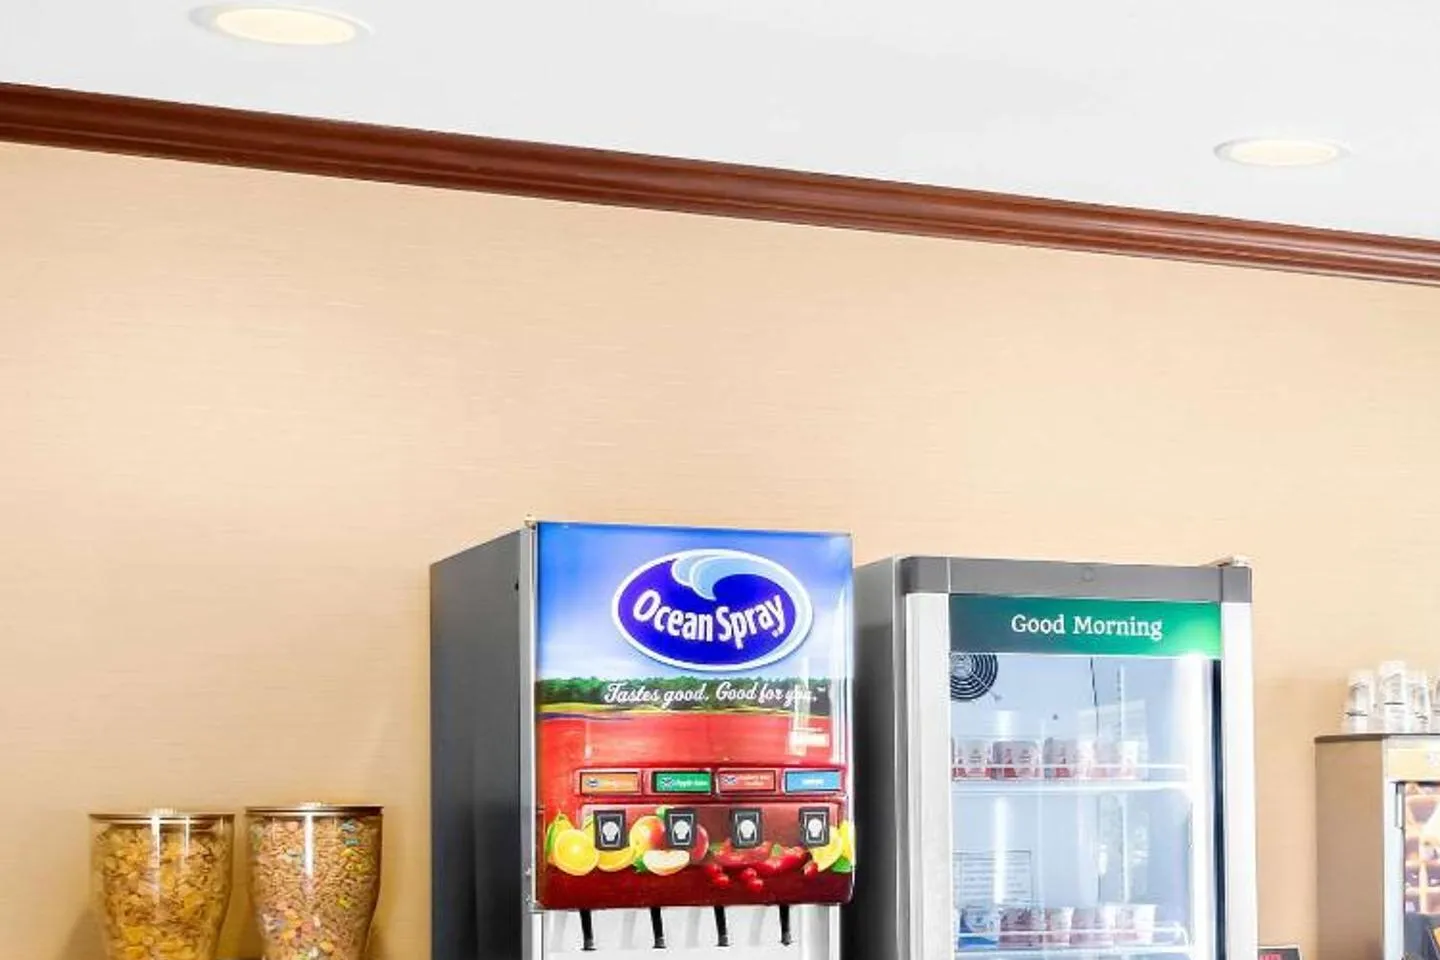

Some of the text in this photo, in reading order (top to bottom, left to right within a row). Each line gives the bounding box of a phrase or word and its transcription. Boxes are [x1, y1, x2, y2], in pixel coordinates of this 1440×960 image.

[632, 589, 786, 650] Ocean Spray
[1011, 613, 1163, 641] Good Morning
[604, 681, 662, 703] Tastes
[664, 683, 710, 709] good.
[715, 681, 757, 701] Good
[758, 684, 784, 706] for
